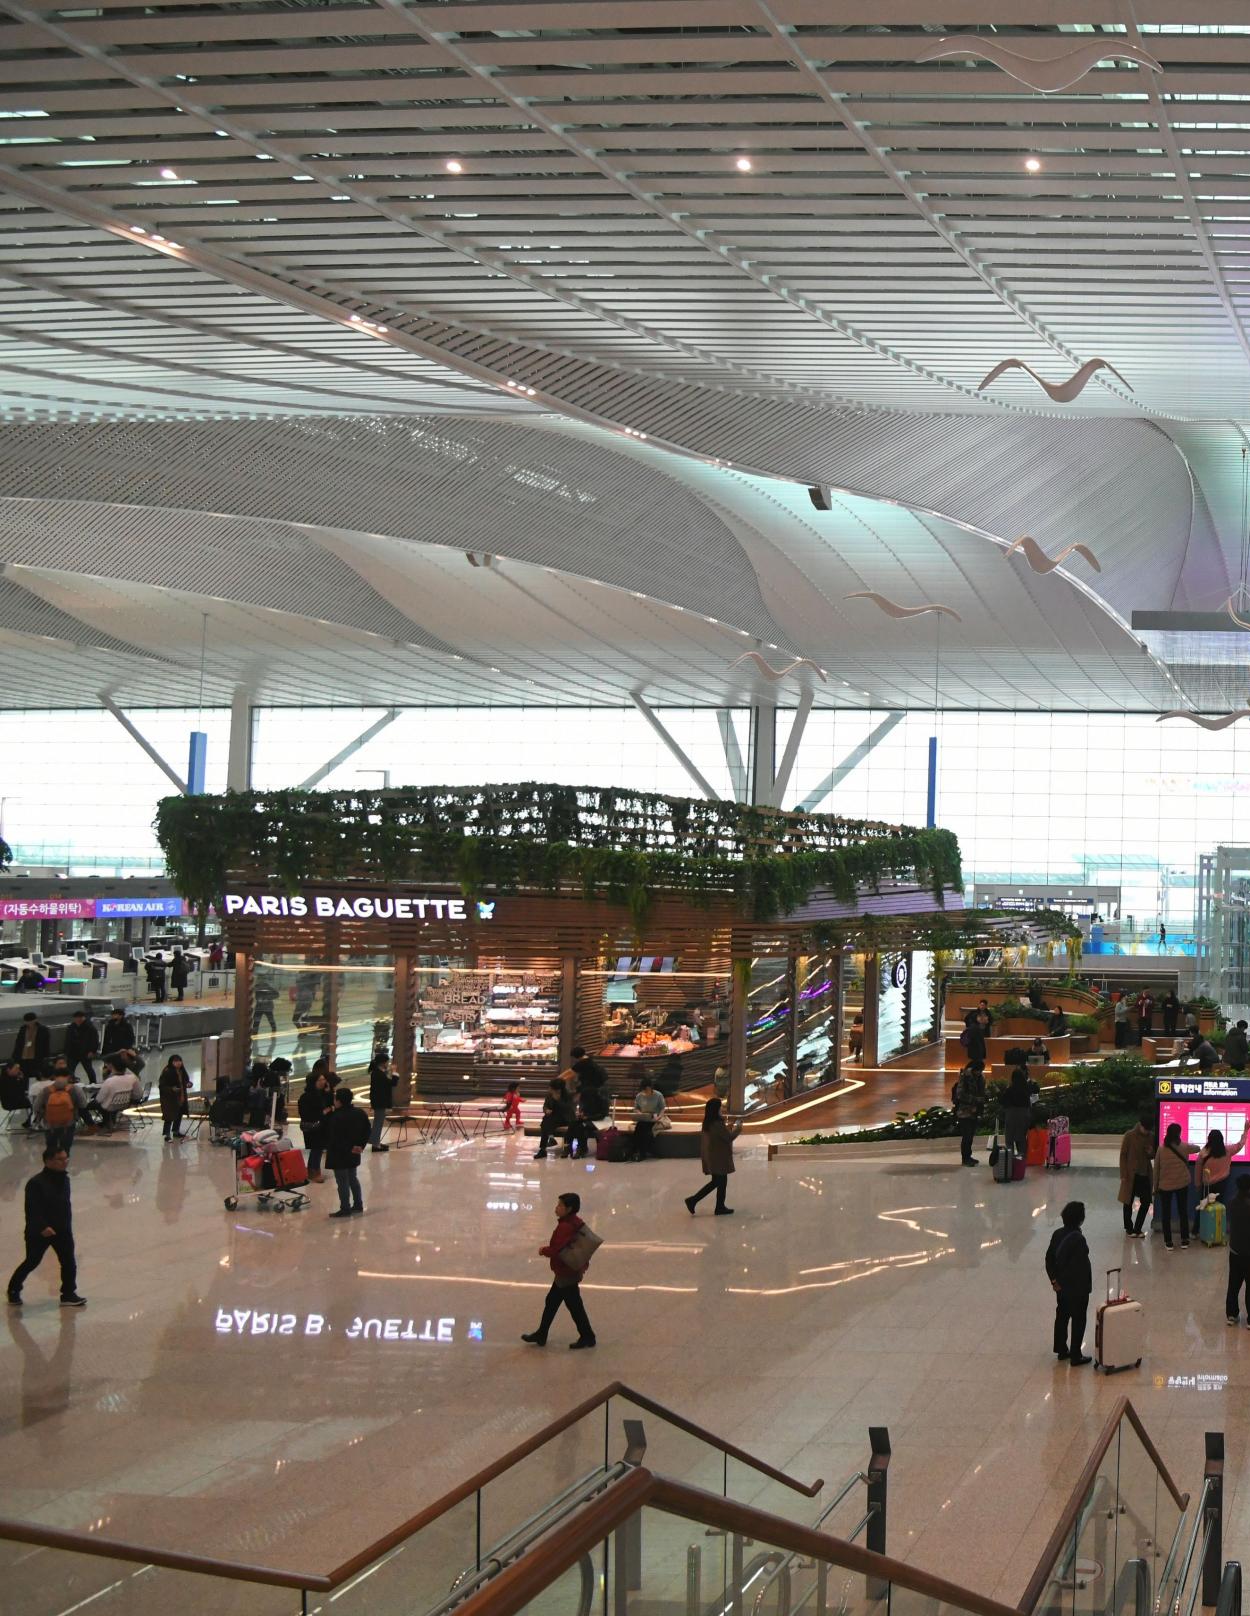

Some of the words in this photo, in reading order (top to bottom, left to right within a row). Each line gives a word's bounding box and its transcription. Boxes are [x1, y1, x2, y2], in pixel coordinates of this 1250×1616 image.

[4, 902, 82, 916] (자동수하물위탁)
[102, 903, 143, 913] KOREAN
[144, 902, 164, 912] AIR
[225, 895, 308, 917] PARIS
[315, 897, 467, 920] BAGUETTE
[444, 995, 486, 1004] BREAD
[1203, 1088, 1238, 1096] Information
